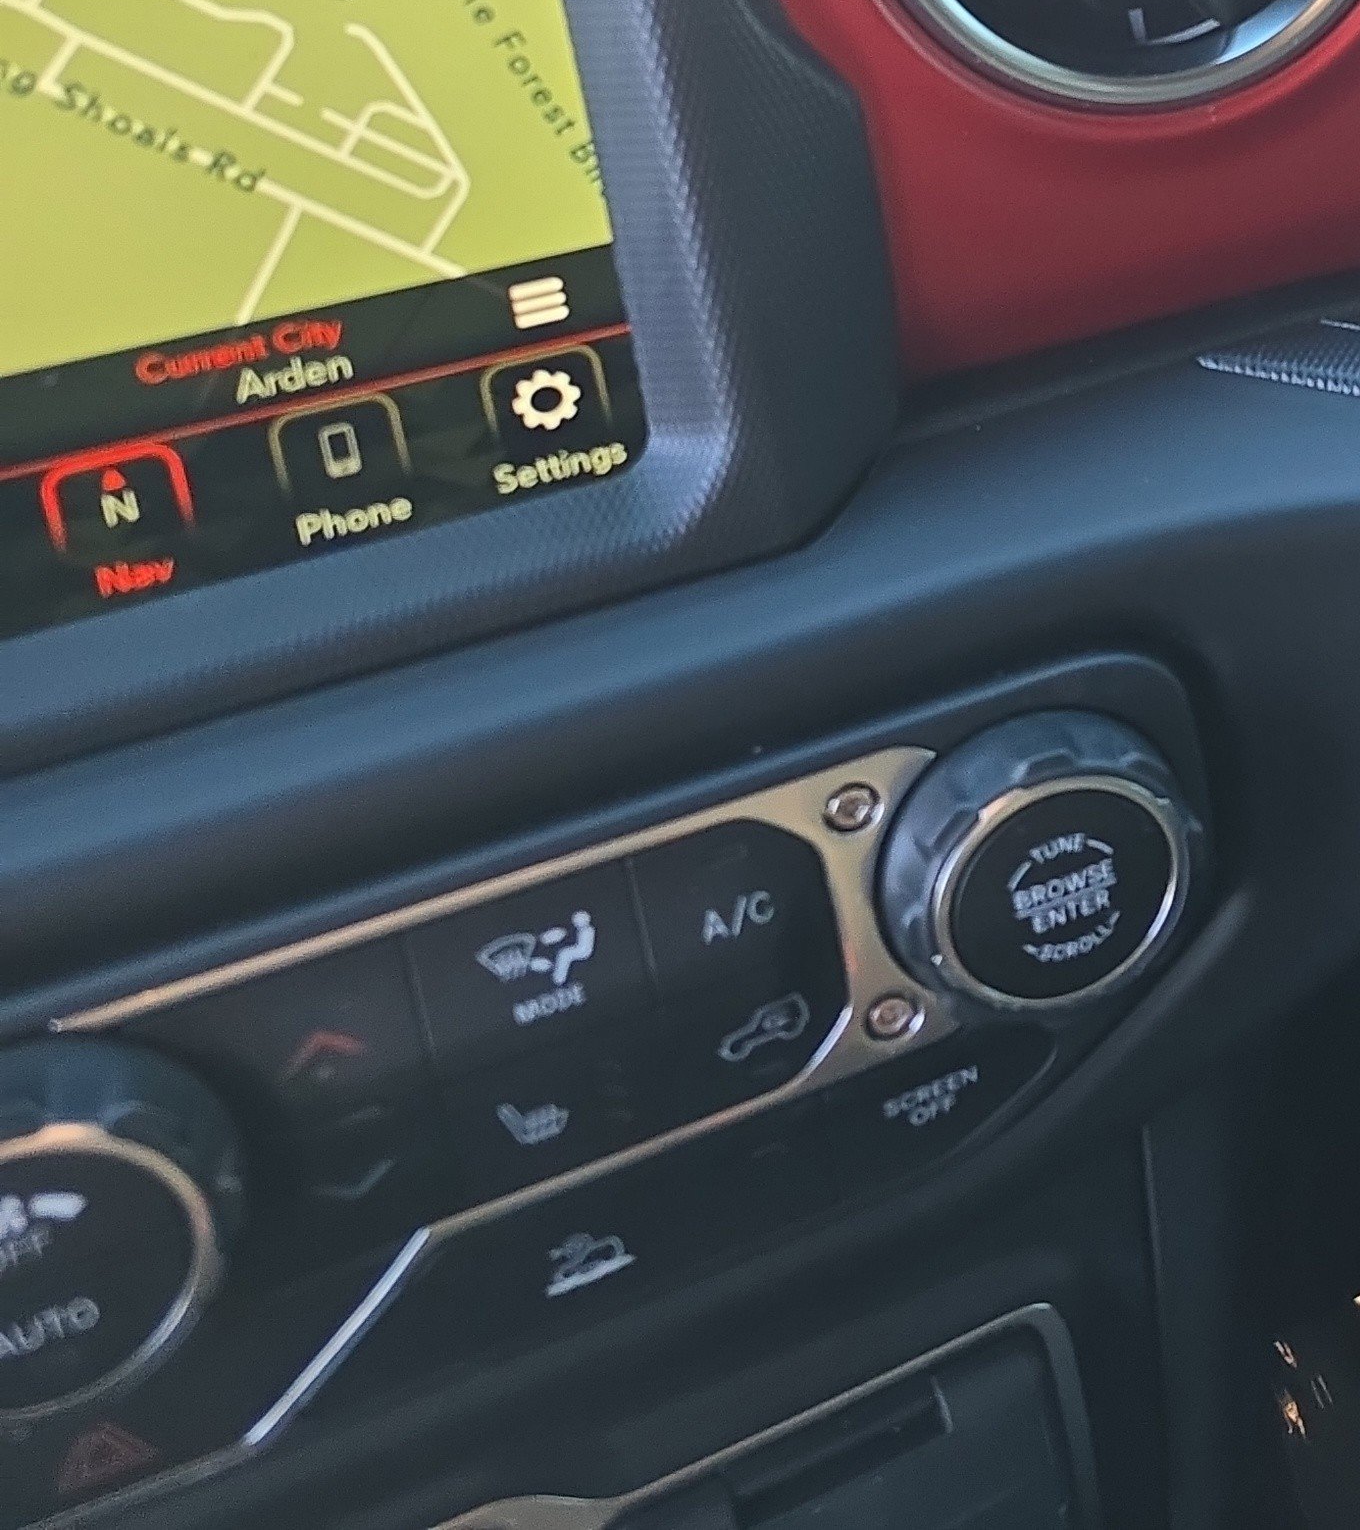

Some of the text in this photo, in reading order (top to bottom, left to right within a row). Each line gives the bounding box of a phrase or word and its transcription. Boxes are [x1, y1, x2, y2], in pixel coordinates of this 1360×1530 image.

[495, 29, 576, 138] Forest
[53, 80, 190, 163] Shoals
[206, 148, 268, 193] Rd
[134, 318, 343, 385] Current City
[235, 353, 353, 404] Arden
[493, 441, 628, 495] Settings
[101, 490, 140, 528] N
[295, 495, 413, 546] Phone
[95, 555, 175, 596] Nav
[1029, 832, 1085, 864] TUNE
[1013, 858, 1118, 913] BROWSE
[1032, 888, 1111, 934] ENTER
[702, 890, 776, 945] A/C
[884, 1065, 978, 1118] SCREEN
[908, 1093, 956, 1126] OFF
